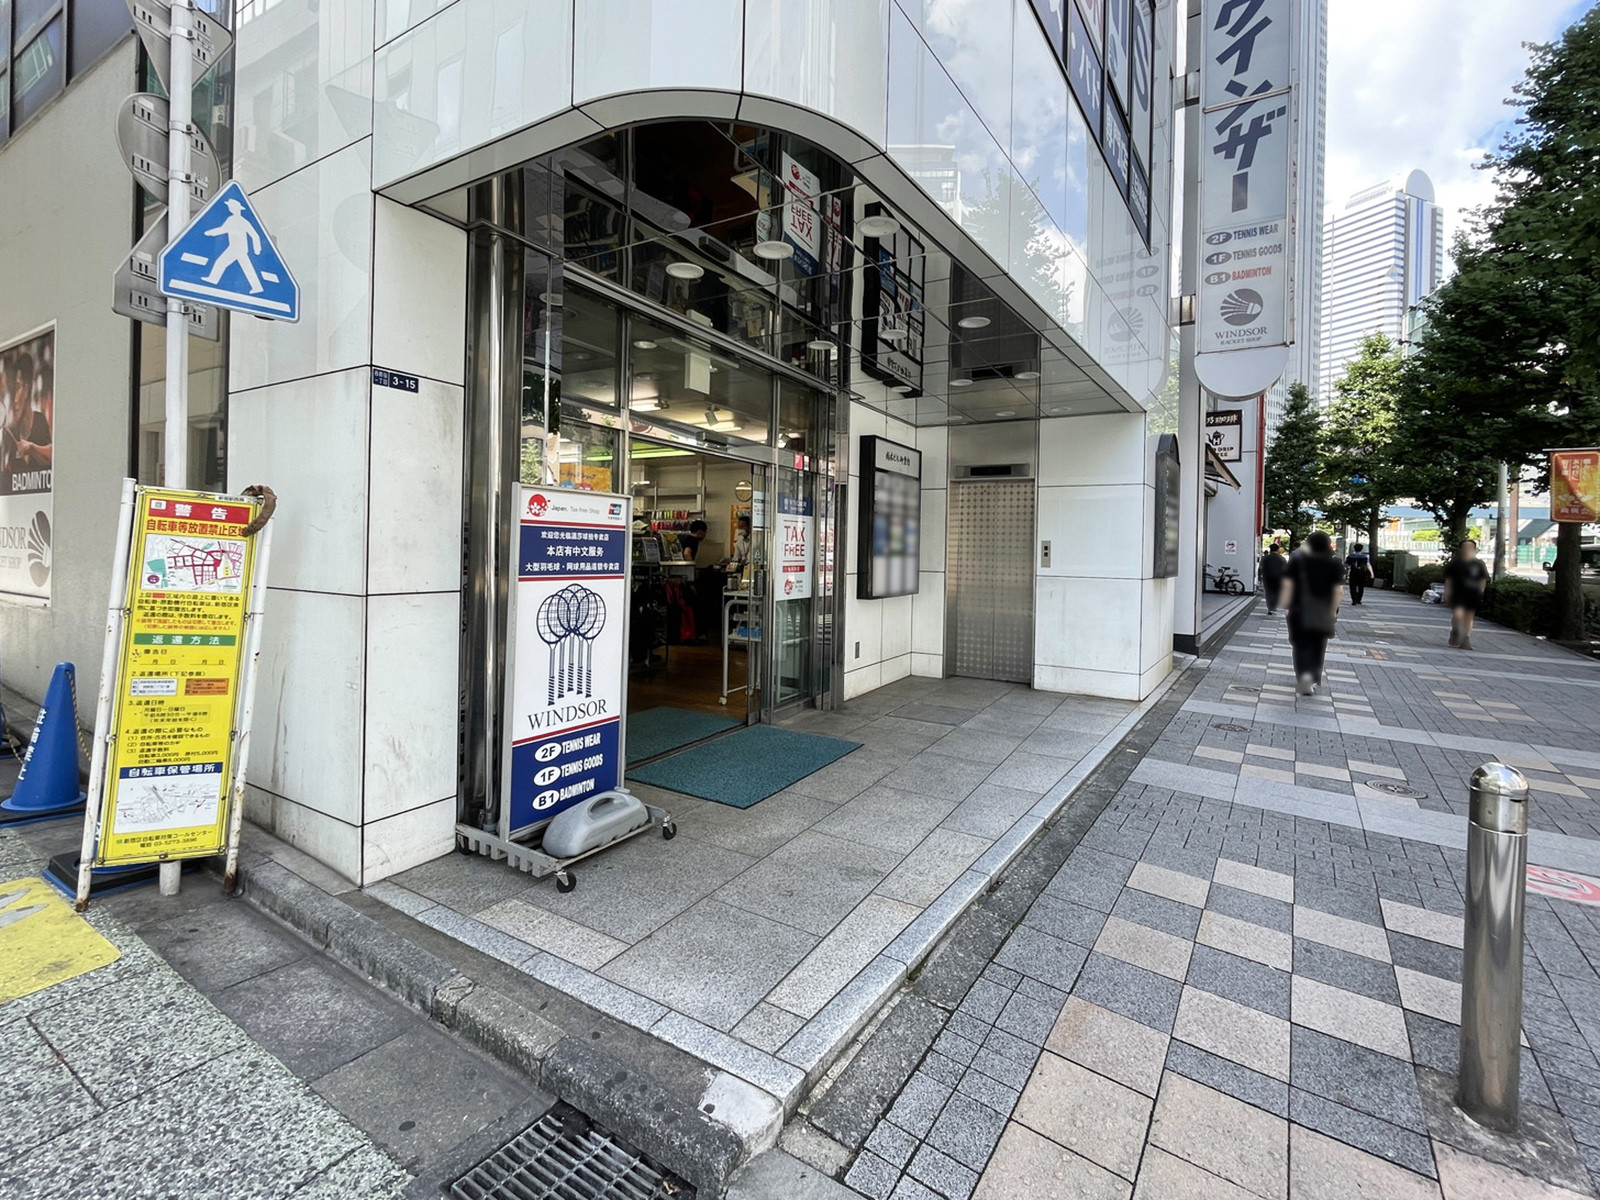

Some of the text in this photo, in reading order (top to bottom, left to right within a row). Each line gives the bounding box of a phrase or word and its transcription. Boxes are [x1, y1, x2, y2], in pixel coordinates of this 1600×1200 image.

[1211, 224, 1279, 244] 2F TENNIS WEAR
[1212, 244, 1283, 264] 1F TENNIS GOODS
[1232, 266, 1272, 281] BADMINTON
[1215, 326, 1268, 340] WINDSOR
[1246, 336, 1262, 344] SHOP
[392, 376, 416, 389] 3-15
[175, 503, 228, 520] 警告
[784, 525, 806, 543] TAX
[546, 545, 604, 557] 本店有中文服务
[784, 543, 805, 557] FREE
[151, 635, 220, 645] 返還方法
[527, 699, 608, 730] WINDSOR
[541, 732, 601, 759] 2F TENNIS WEAR
[128, 763, 216, 778] 自転車保管場所
[540, 753, 604, 783] 1F TENNIS GOODS
[538, 778, 595, 807] B1 BADMINTON
